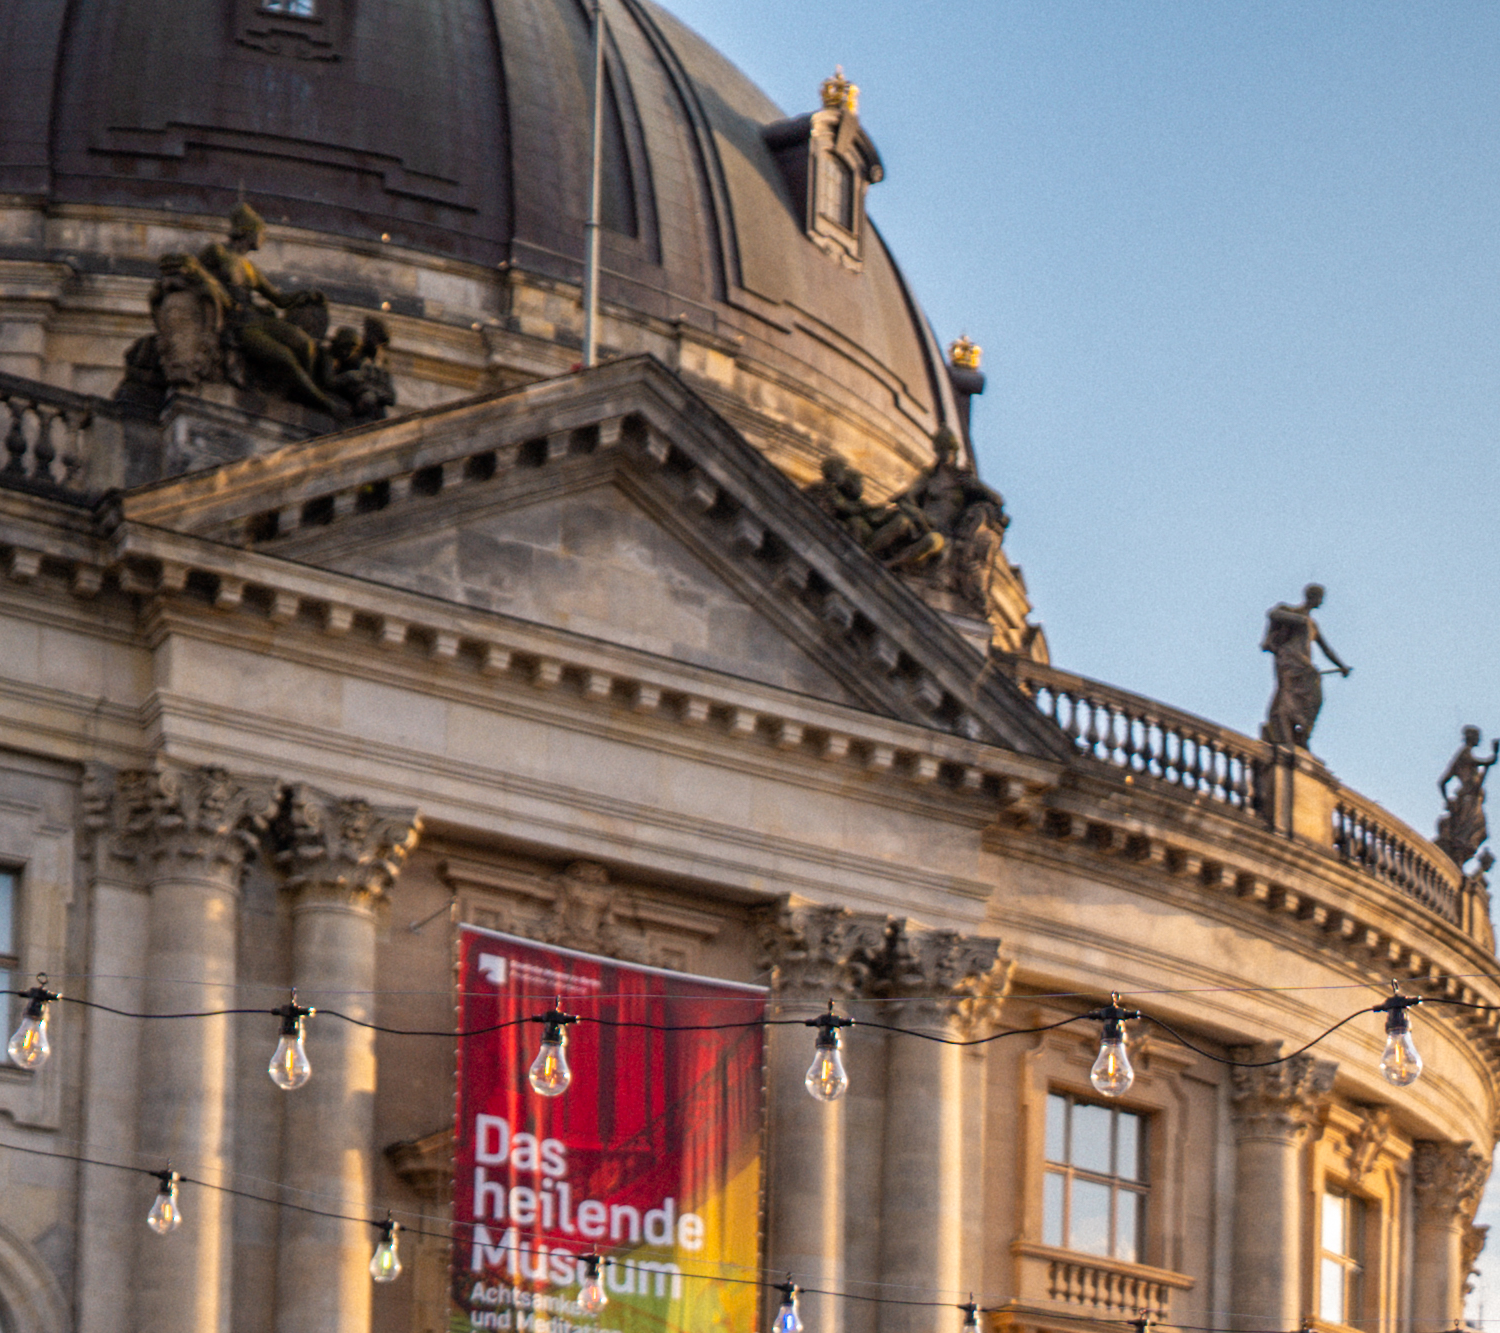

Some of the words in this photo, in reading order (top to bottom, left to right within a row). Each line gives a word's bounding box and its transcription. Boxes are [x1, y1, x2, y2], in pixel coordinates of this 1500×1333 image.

[475, 1113, 567, 1178] Das
[473, 1166, 704, 1251] heilende
[470, 1281, 598, 1319] Achtsamke
[471, 1310, 511, 1330] und
